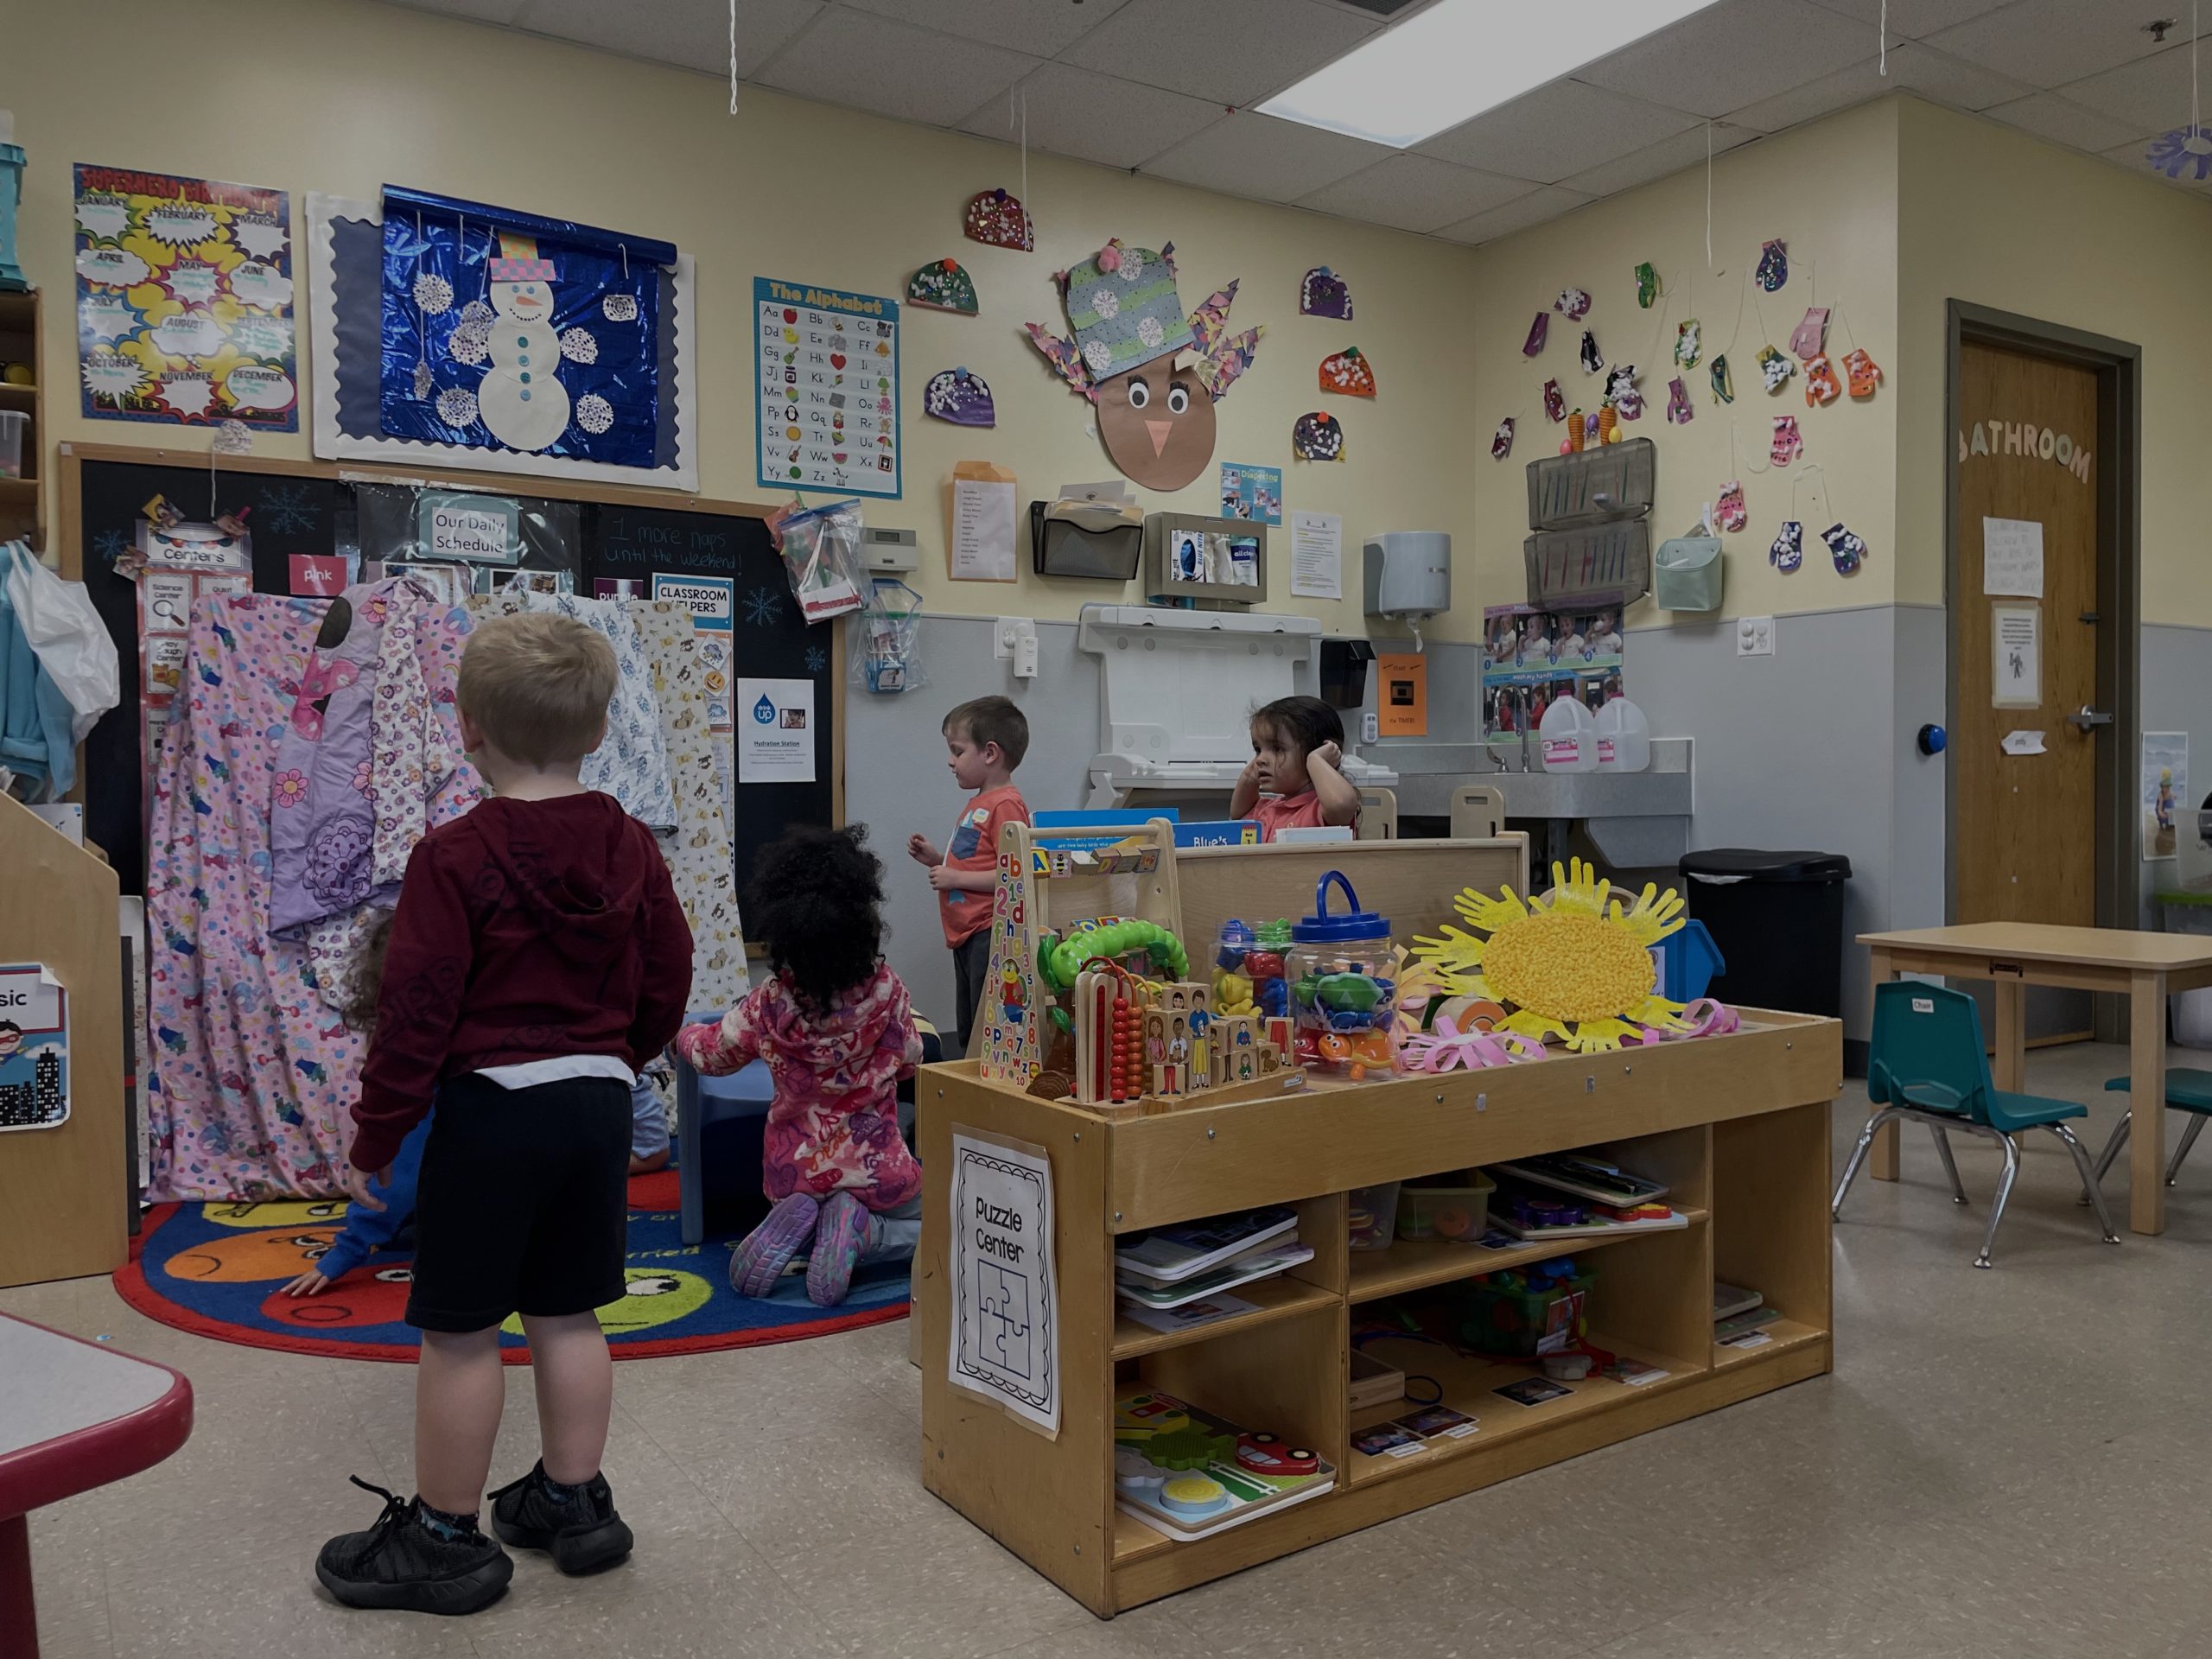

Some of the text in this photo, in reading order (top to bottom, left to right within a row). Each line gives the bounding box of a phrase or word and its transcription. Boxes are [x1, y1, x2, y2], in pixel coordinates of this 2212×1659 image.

[80, 168, 179, 199] SUPERHERO
[156, 209, 207, 221] FEBRUARY
[238, 215, 276, 227] MARCH
[97, 252, 124, 263] APRIL
[178, 260, 203, 271] MAY
[241, 264, 266, 276] JUNE
[769, 282, 883, 315] The Alphabet
[166, 318, 206, 330] AUGUST
[763, 306, 871, 332] Aa Bb Cc
[764, 326, 870, 351] Dd Ee Ff
[88, 358, 134, 368] OCTOBER
[764, 346, 779, 361] Gg
[810, 353, 823, 364] Hh
[159, 371, 213, 381] NOVEMBER
[232, 369, 283, 382] DECEMBER
[766, 366, 778, 381] Jj
[811, 372, 823, 384] Kk
[764, 386, 873, 410] Mm Nn Oo
[767, 406, 873, 429] Pp Qq Rr
[767, 426, 873, 448] Ss Tt Uu
[767, 446, 873, 467] Vv Ww Xx
[767, 467, 826, 482] Yy Zz
[435, 514, 505, 535] Our Daily
[436, 536, 503, 553] Schedule
[638, 526, 683, 545] more
[691, 531, 727, 552] naps
[164, 548, 226, 564] Centers
[605, 546, 646, 563] until
[652, 548, 673, 564] the
[304, 569, 333, 582] pink
[152, 583, 184, 592] Science
[661, 588, 727, 601] CLASSROOM
[758, 710, 772, 721] up
[1193, 836, 1228, 847] Blue's
[1001, 855, 1008, 868] a
[1010, 853, 1021, 877] b
[1033, 853, 1046, 871] A
[1002, 873, 1007, 882] c
[1009, 883, 1017, 901] 1
[1016, 883, 1023, 893] e
[996, 887, 1007, 916] 2
[1013, 900, 1024, 924] d
[995, 921, 1003, 945] f
[1007, 918, 1014, 937] h
[1013, 938, 1022, 957] g
[991, 953, 999, 971] 4
[1024, 954, 1029, 968] 3
[988, 975, 994, 995] j
[1027, 975, 1033, 984] 5
[986, 1001, 994, 1022] 6
[1029, 1012, 1035, 1024] r
[994, 1028, 1001, 1045] p
[1005, 1026, 1012, 1034] m
[1028, 1027, 1035, 1045] 8
[984, 1041, 991, 1059] 9
[1007, 1038, 1014, 1051] q
[1016, 1037, 1023, 1054] 7
[1003, 1051, 1008, 1063] n
[982, 1065, 988, 1078] u
[1000, 1066, 1005, 1079] y
[1022, 1063, 1027, 1073] z
[976, 1196, 1022, 1232] Puzzle
[976, 1228, 1024, 1263] Center
